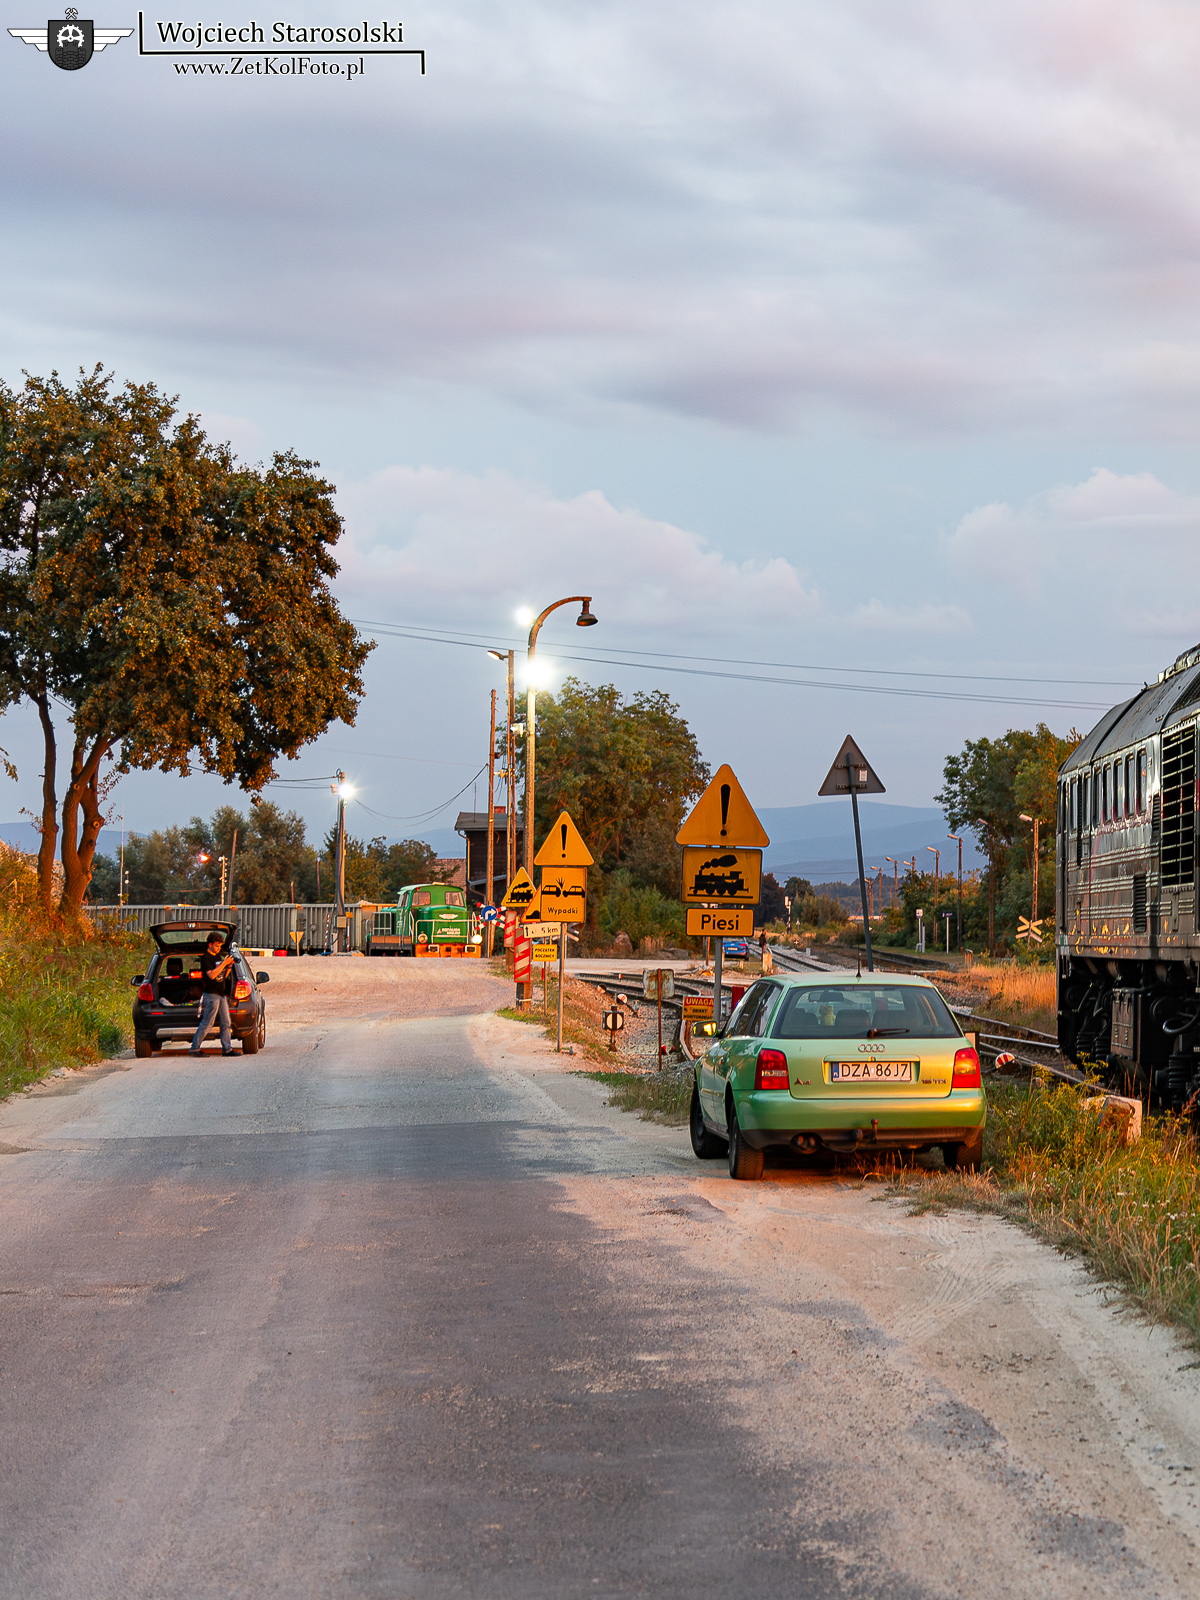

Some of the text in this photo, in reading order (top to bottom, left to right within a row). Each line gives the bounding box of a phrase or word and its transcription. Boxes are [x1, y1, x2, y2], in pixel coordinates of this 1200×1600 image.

[547, 907, 578, 915] Wypadki
[701, 914, 739, 930] Piesi
[686, 998, 714, 1006] UWAGA
[841, 1063, 909, 1077] DZA 86J7
